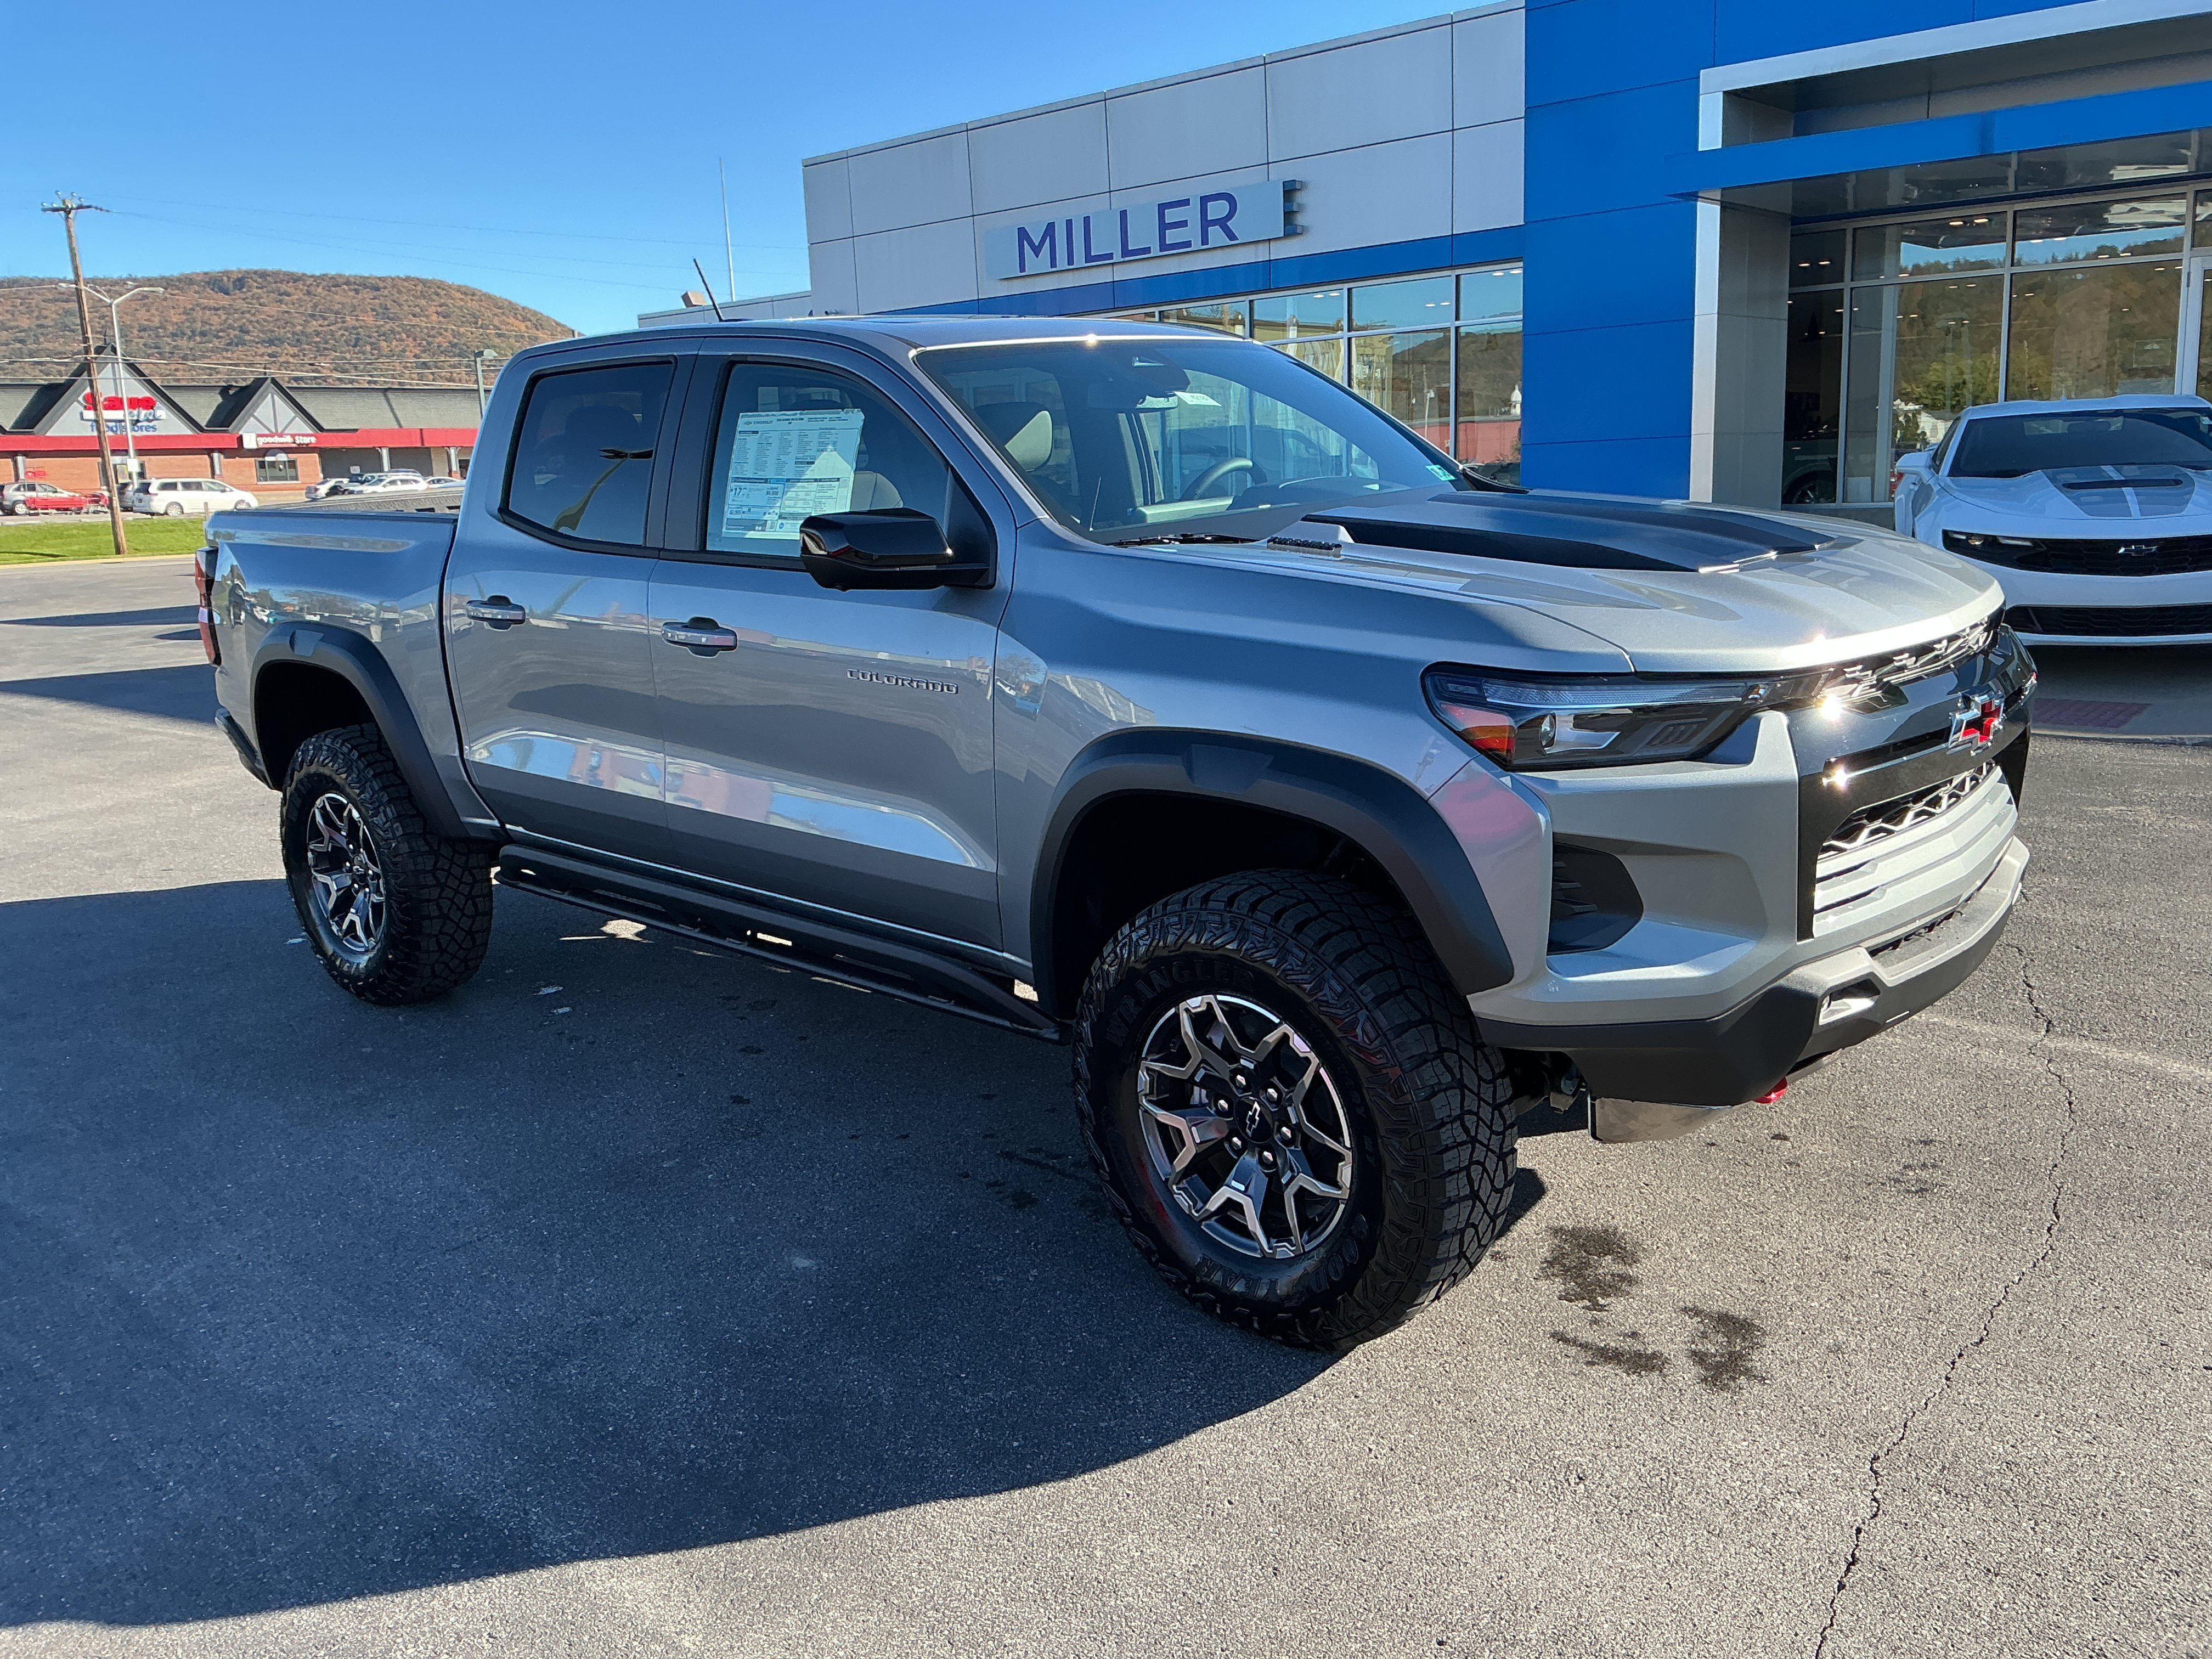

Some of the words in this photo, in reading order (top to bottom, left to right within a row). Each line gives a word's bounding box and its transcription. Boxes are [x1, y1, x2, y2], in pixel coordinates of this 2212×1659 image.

[1017, 192, 1239, 273] MILLER
[89, 421, 119, 432] fod
[257, 435, 292, 445] goodwill
[847, 668, 959, 695] COLORADO
[1105, 958, 1256, 1049] WRANGLER
